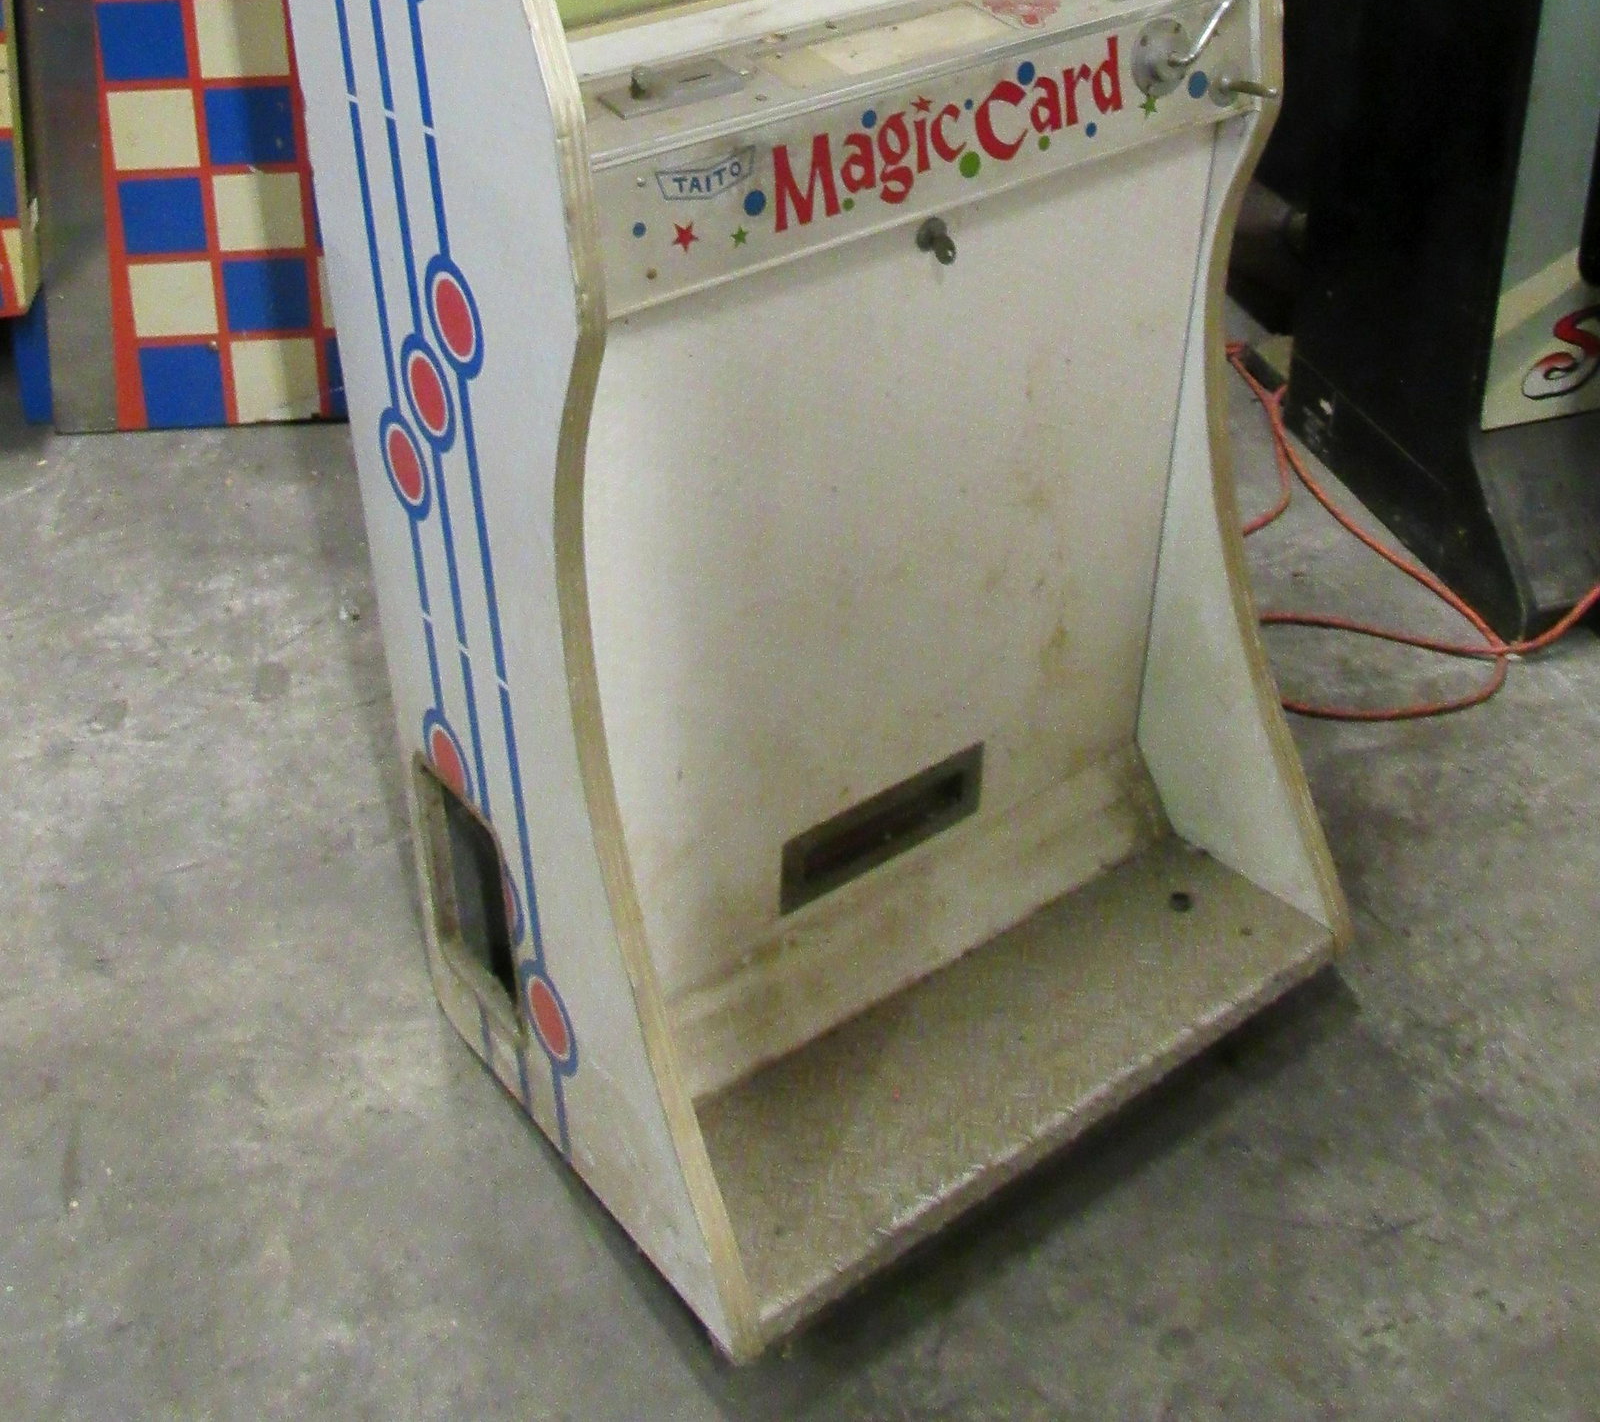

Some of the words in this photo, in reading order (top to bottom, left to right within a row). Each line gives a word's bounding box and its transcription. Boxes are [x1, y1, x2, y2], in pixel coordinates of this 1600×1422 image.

[671, 161, 741, 194] TAITO
[772, 96, 966, 233] Magic
[974, 35, 1123, 161] Card
